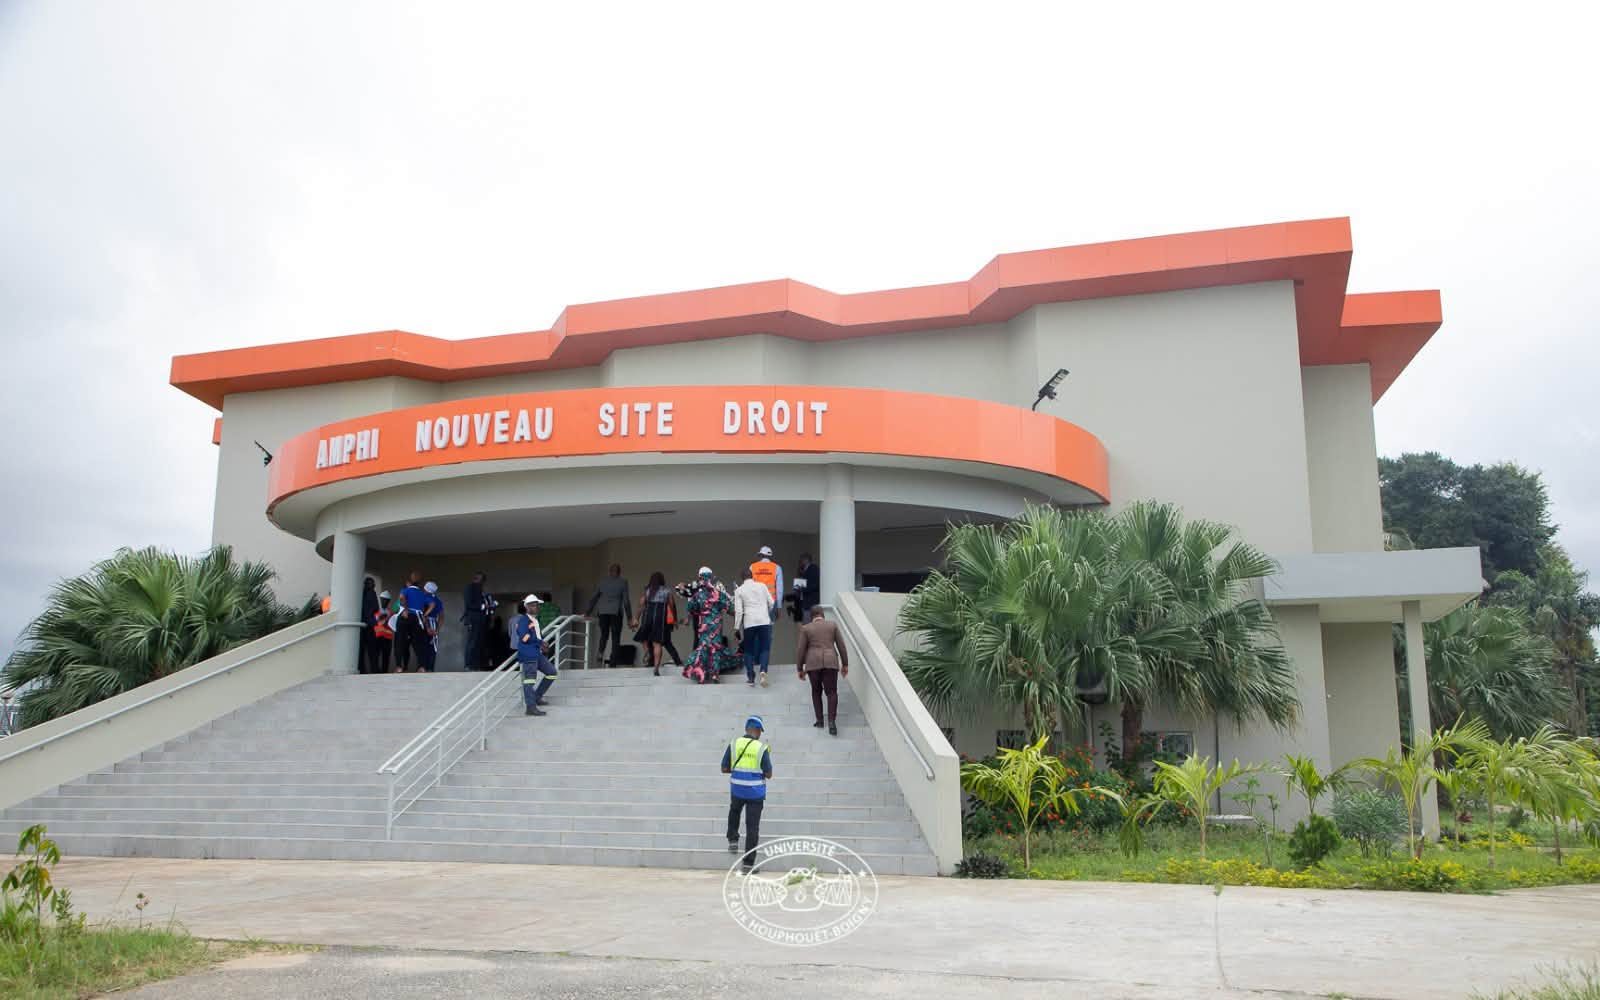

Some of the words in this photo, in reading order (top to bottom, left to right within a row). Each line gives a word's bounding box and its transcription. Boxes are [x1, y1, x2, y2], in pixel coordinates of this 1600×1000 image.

[315, 428, 379, 469] AMPHI
[415, 407, 553, 452] NOUVEAU
[598, 402, 673, 436] SITE
[723, 399, 828, 434] DROIT
